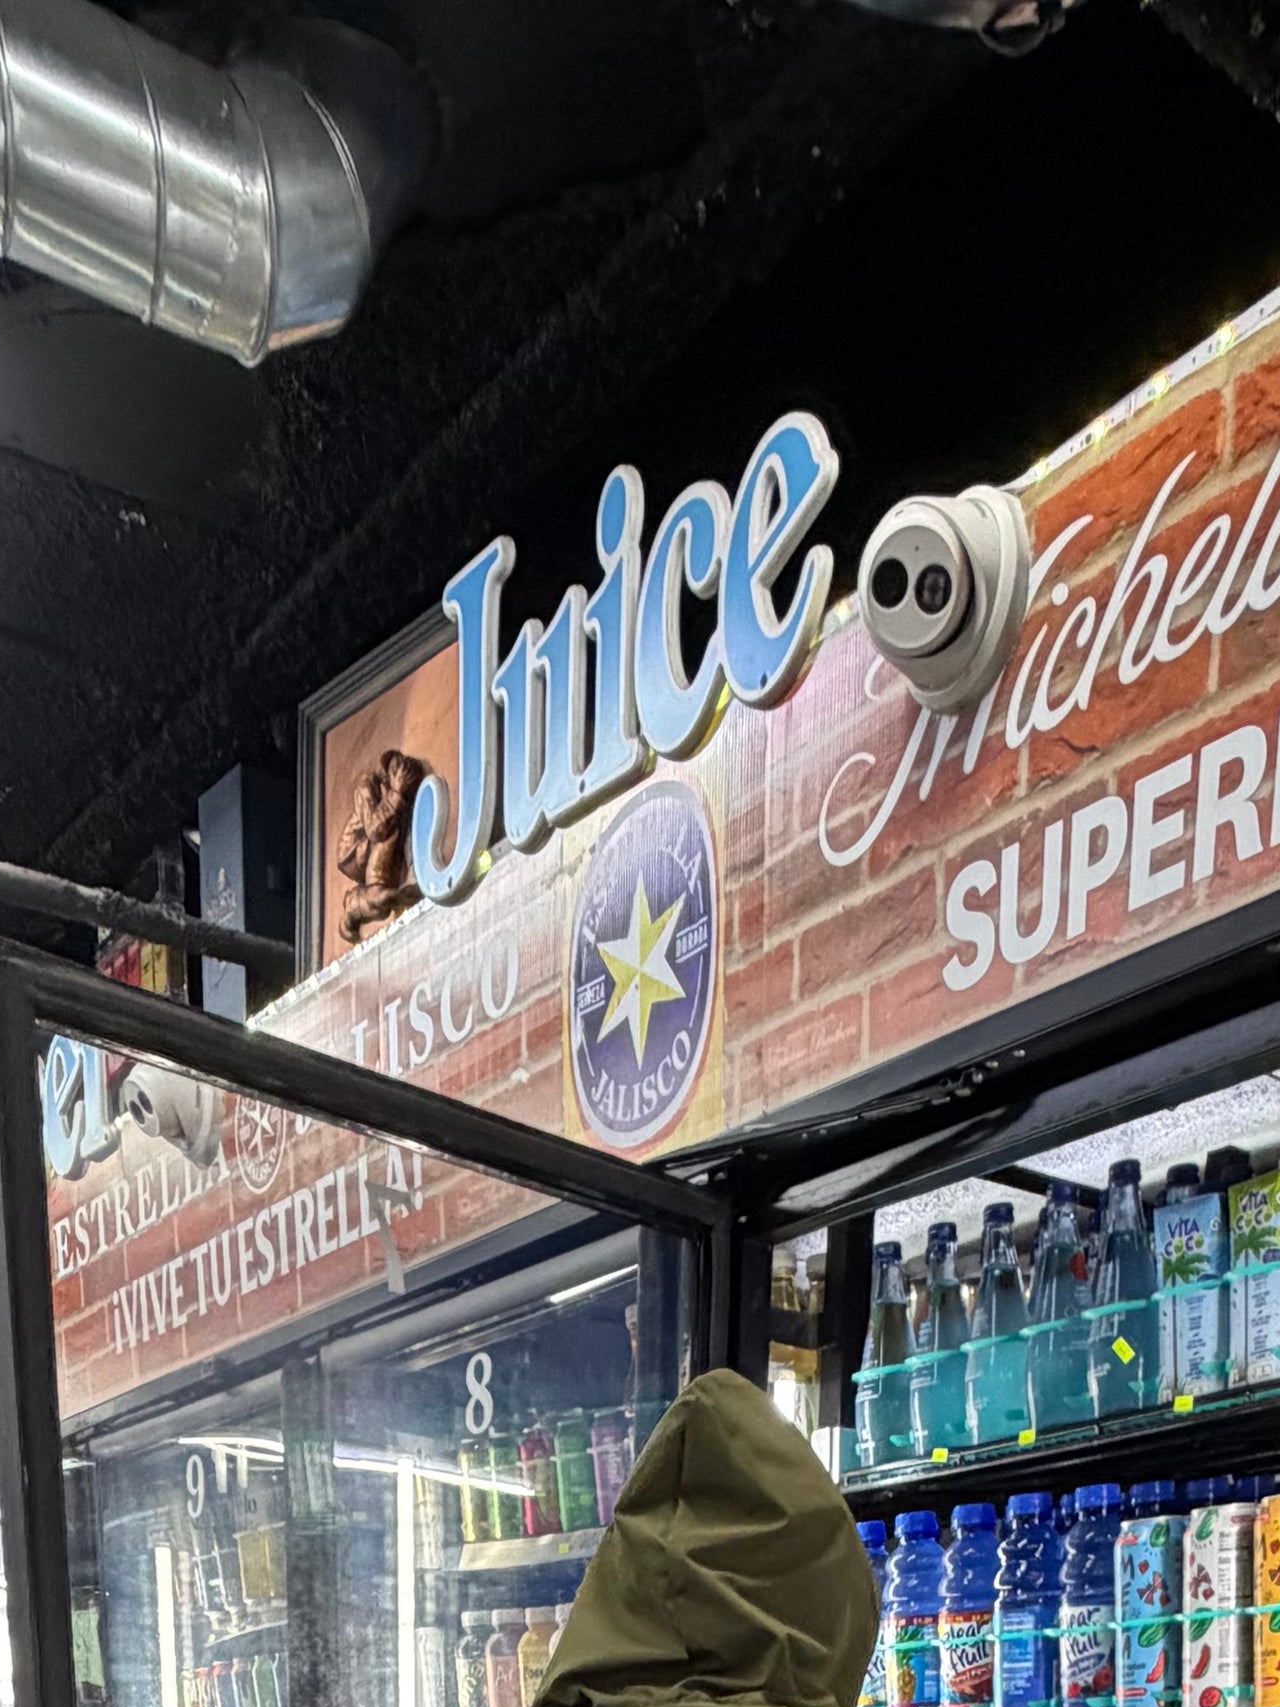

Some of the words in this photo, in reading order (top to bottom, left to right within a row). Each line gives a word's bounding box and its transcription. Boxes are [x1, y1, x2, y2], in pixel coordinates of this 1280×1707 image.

[411, 411, 839, 906] Juice
[592, 1030, 691, 1122] JALISCO
[1167, 1216, 1200, 1240] VITA
[1234, 1210, 1273, 1234] COCO
[1238, 1190, 1270, 1214] VITA
[1163, 1235, 1206, 1258] COCO
[191, 1243, 232, 1318] TU
[465, 1352, 494, 1434] 8
[186, 1454, 205, 1518] 9
